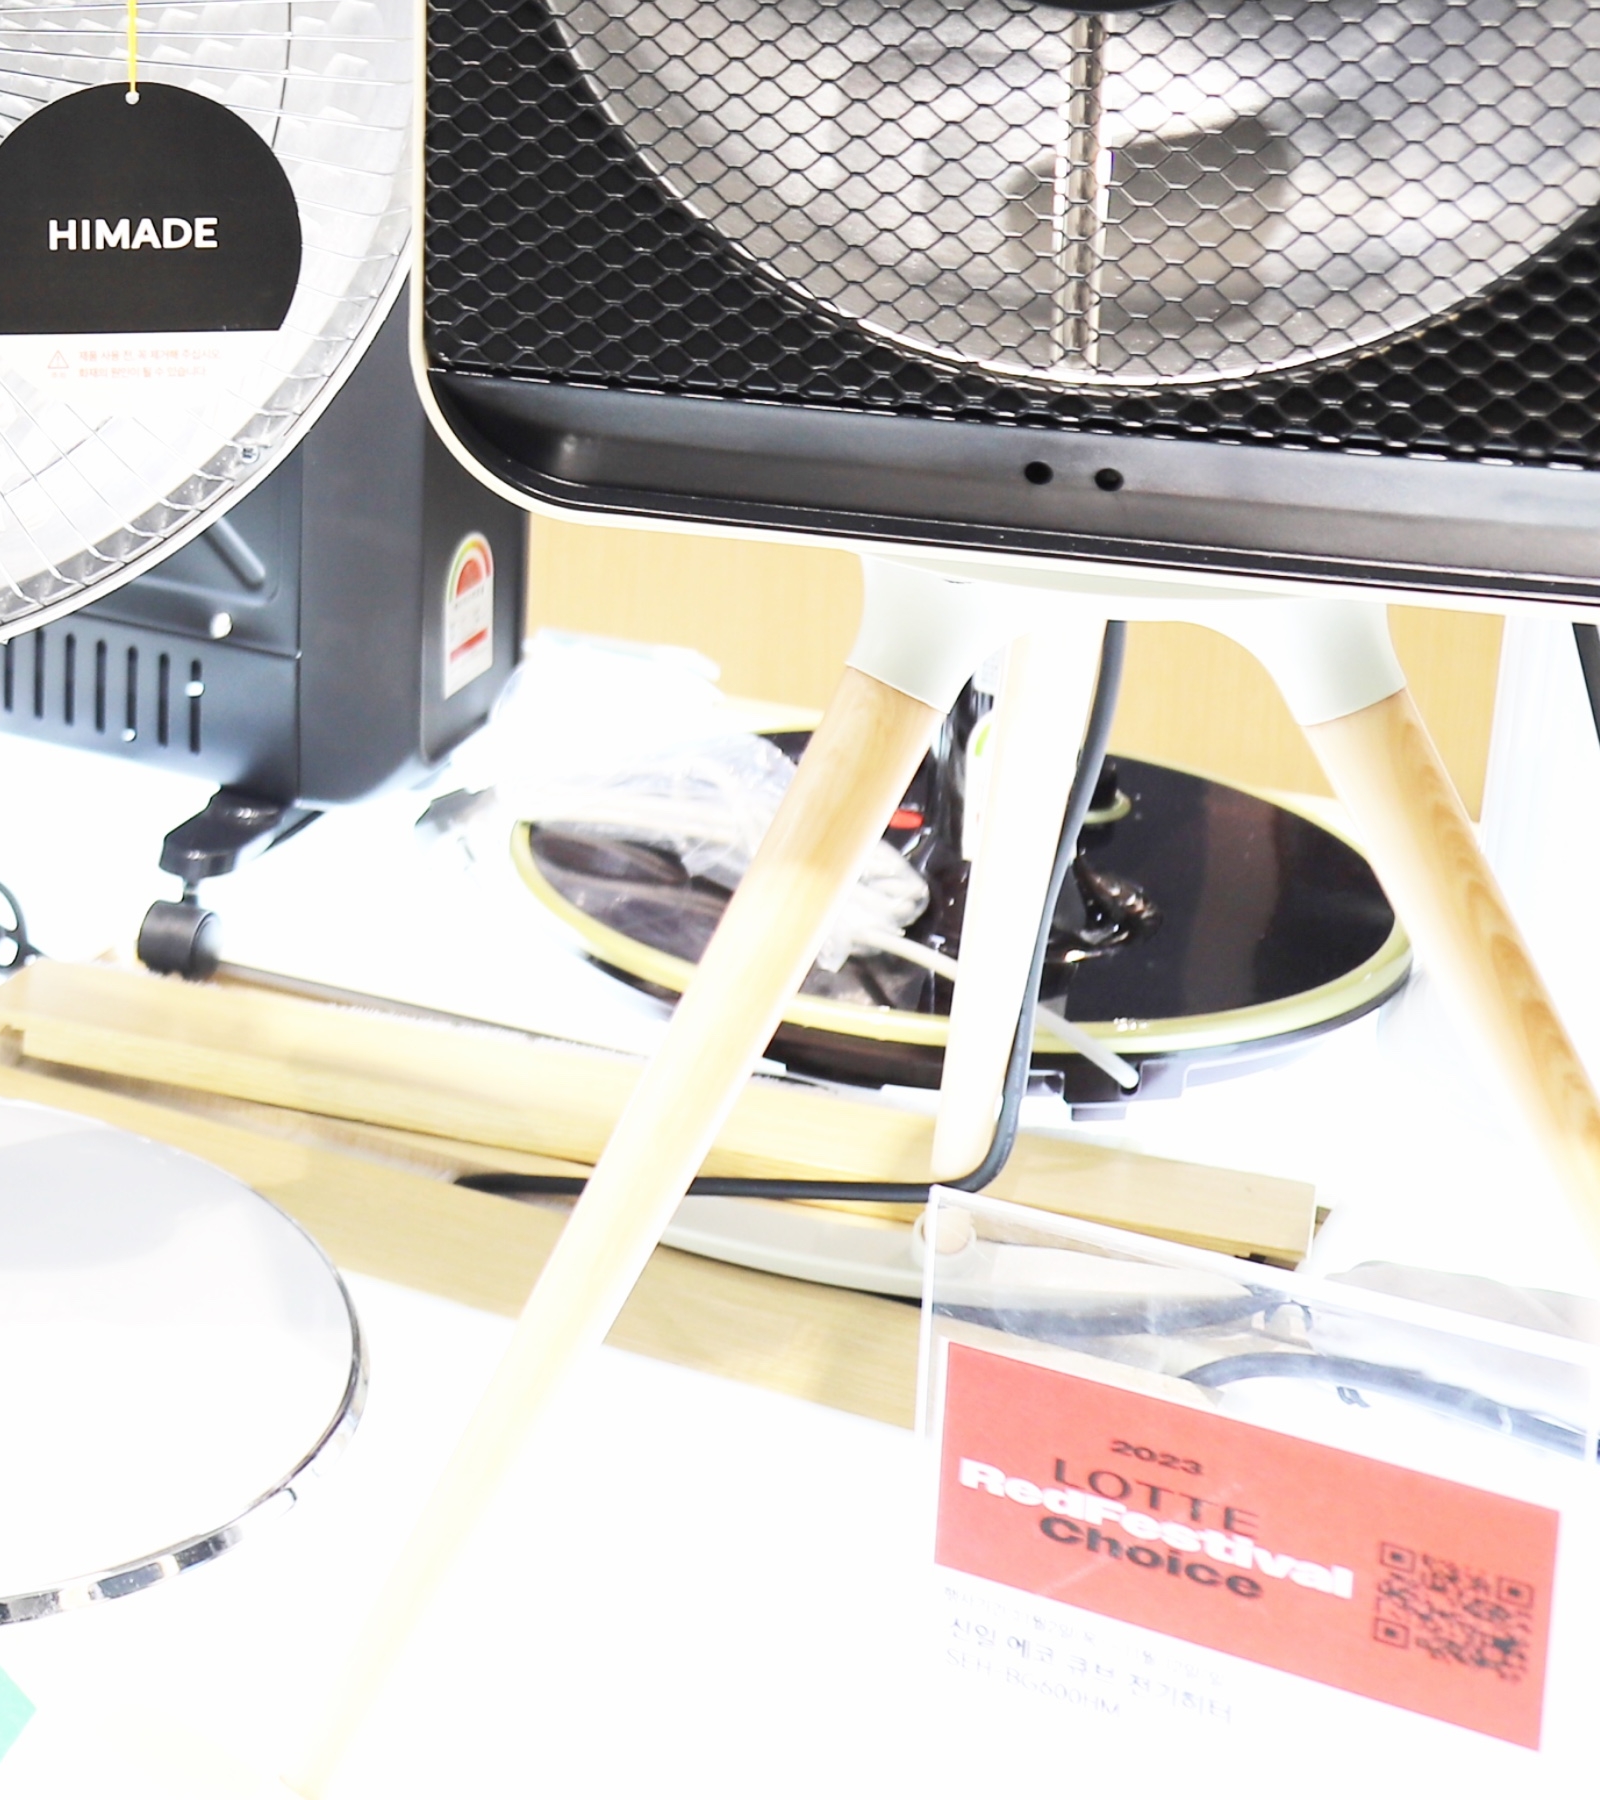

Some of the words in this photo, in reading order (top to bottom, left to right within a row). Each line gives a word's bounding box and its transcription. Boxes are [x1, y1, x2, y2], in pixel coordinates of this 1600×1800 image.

[47, 216, 219, 252] HIMADE
[1053, 1457, 1261, 1539] LOTTE
[1110, 1438, 1204, 1475] 2023
[958, 1457, 1355, 1599] RedFestival
[1039, 1515, 1263, 1600] Choice
[949, 1616, 998, 1650] 신일
[1006, 1634, 1056, 1666] 에코
[1066, 1654, 1116, 1685] 큐브
[1127, 1672, 1233, 1724] 전기히터
